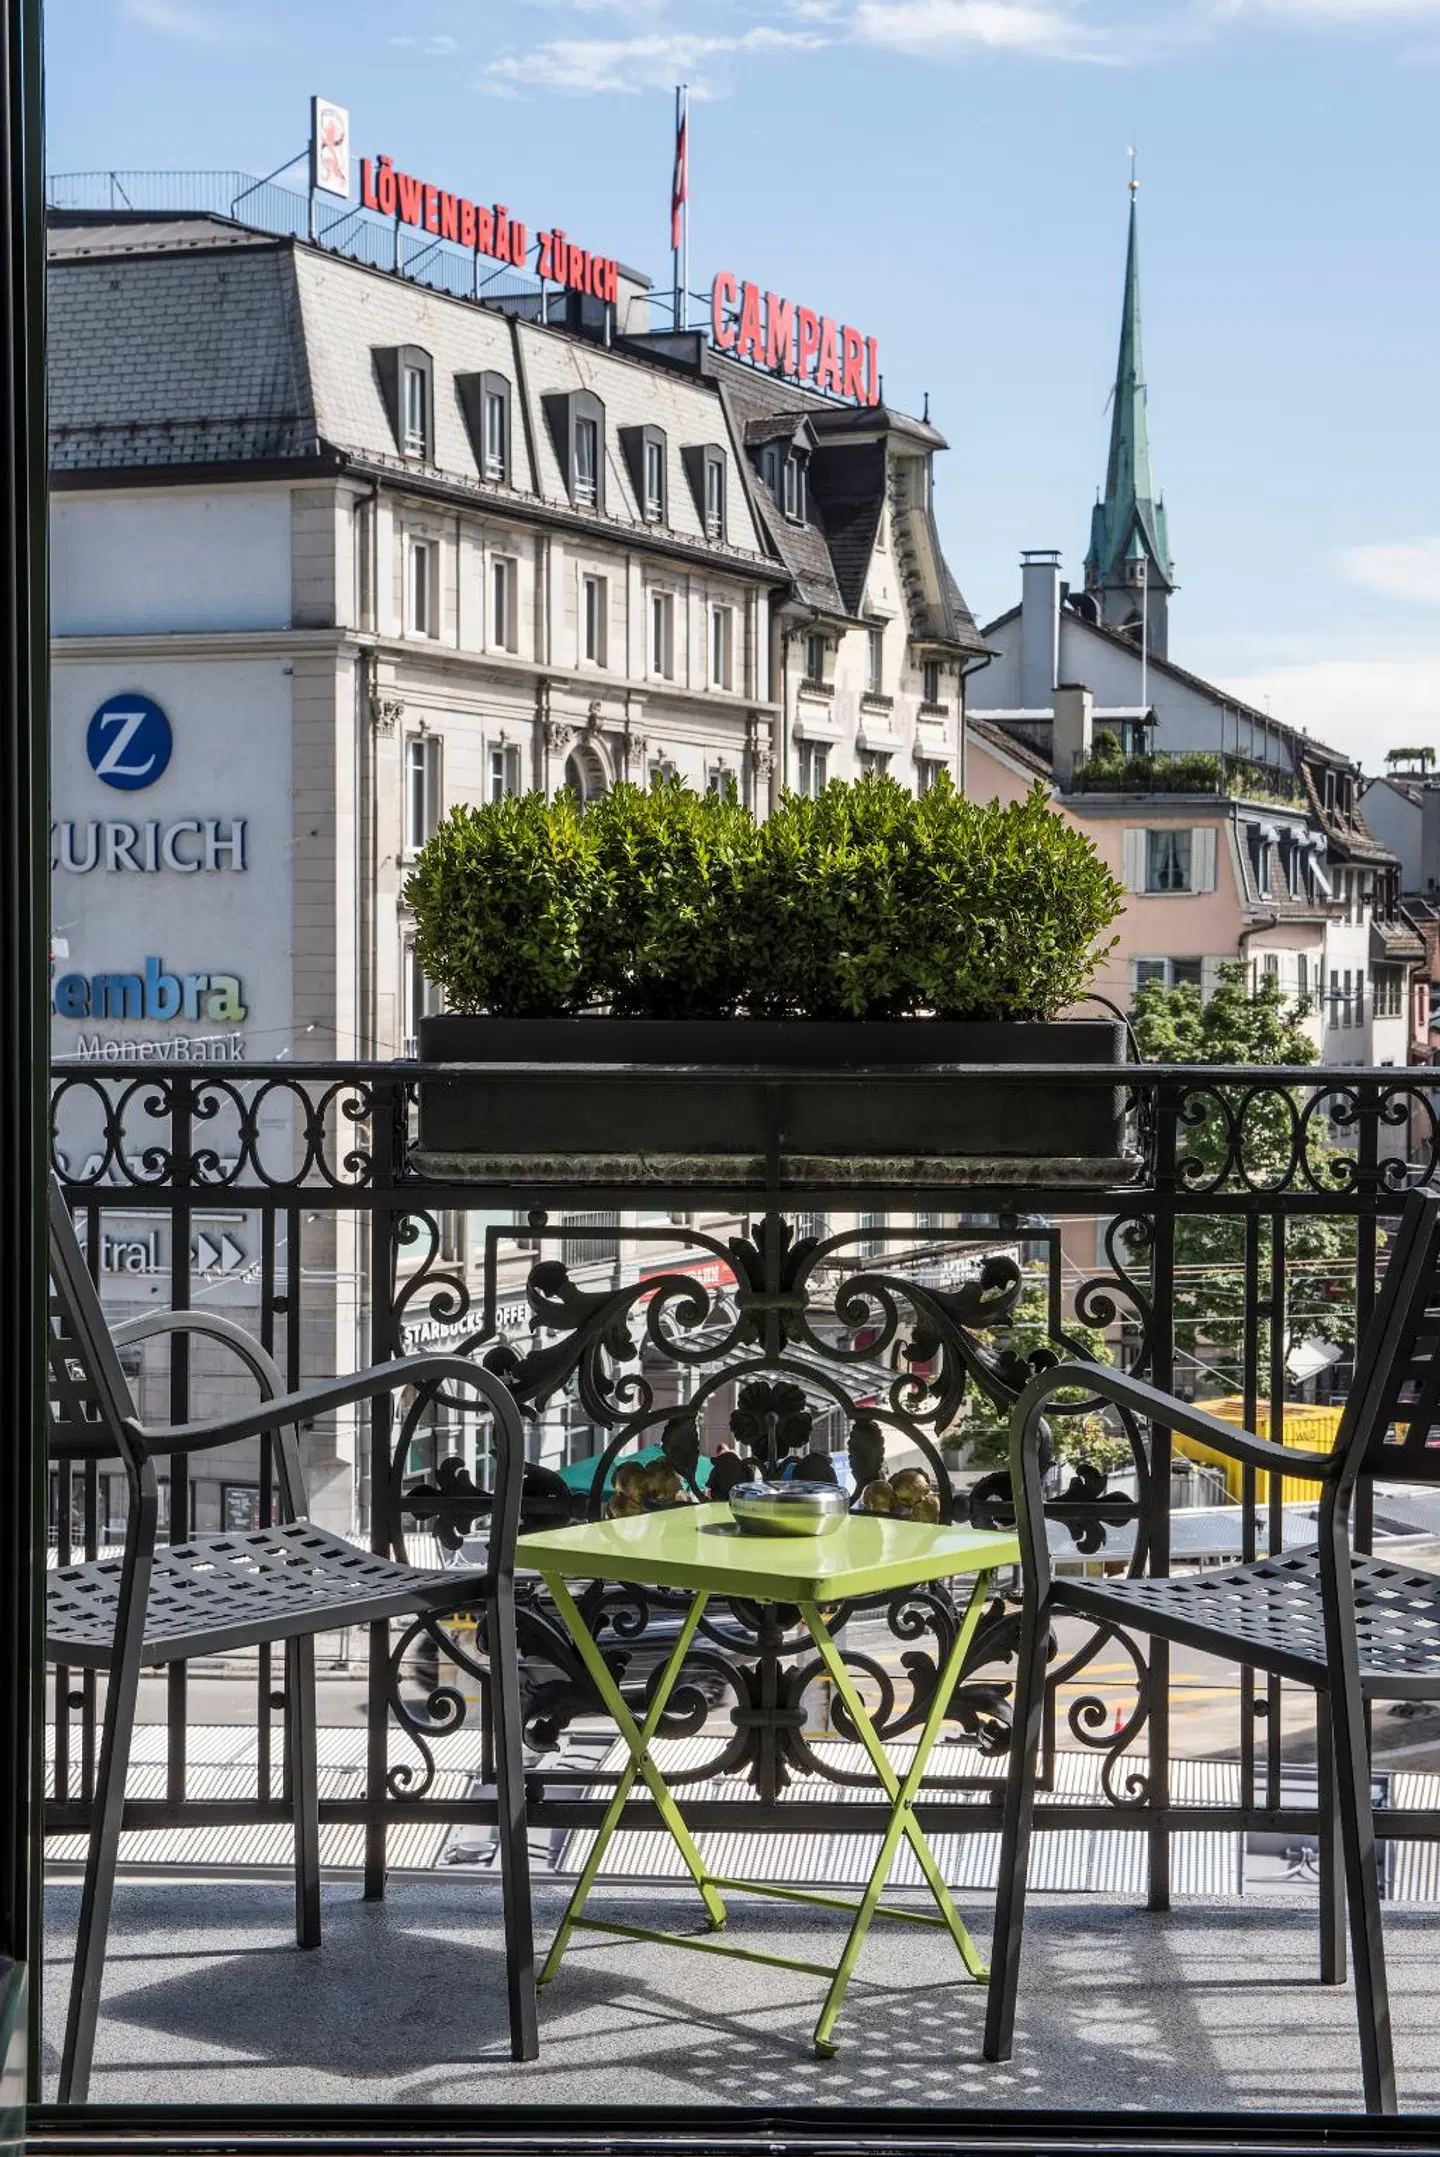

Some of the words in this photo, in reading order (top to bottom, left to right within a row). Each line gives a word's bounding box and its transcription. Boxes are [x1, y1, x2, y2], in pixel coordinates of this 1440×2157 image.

[360, 153, 527, 268] LÖWENBRÄU
[536, 228, 619, 303] ZÜRICH
[711, 270, 880, 407] CAMPARI
[96, 712, 157, 776] Z
[51, 819, 247, 873] URICH
[51, 955, 248, 1022] embra
